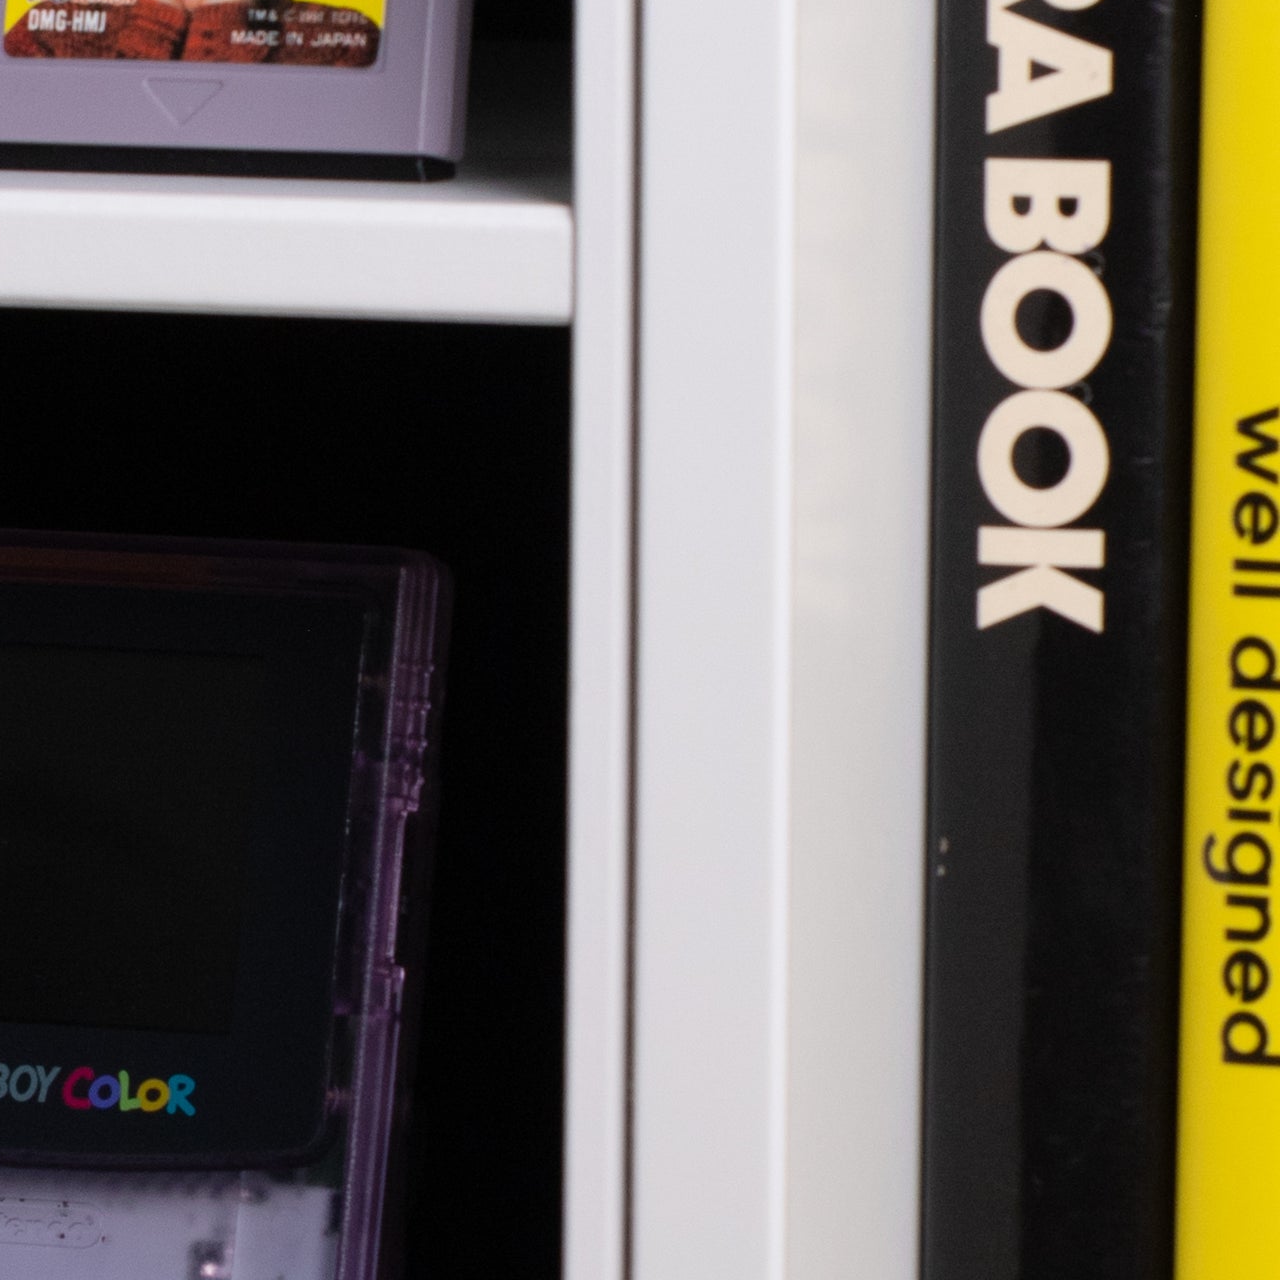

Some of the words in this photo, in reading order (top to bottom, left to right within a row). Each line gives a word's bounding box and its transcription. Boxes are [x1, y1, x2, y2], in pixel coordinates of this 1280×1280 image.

[27, 9, 107, 33] DMG-HMJ
[229, 29, 280, 46] MADE
[285, 30, 304, 46] IN
[310, 31, 368, 48] JAPAN
[976, 158, 1113, 635] BOOK
[1202, 636, 1280, 1068] designed
[62, 1066, 199, 1118] COLOR
